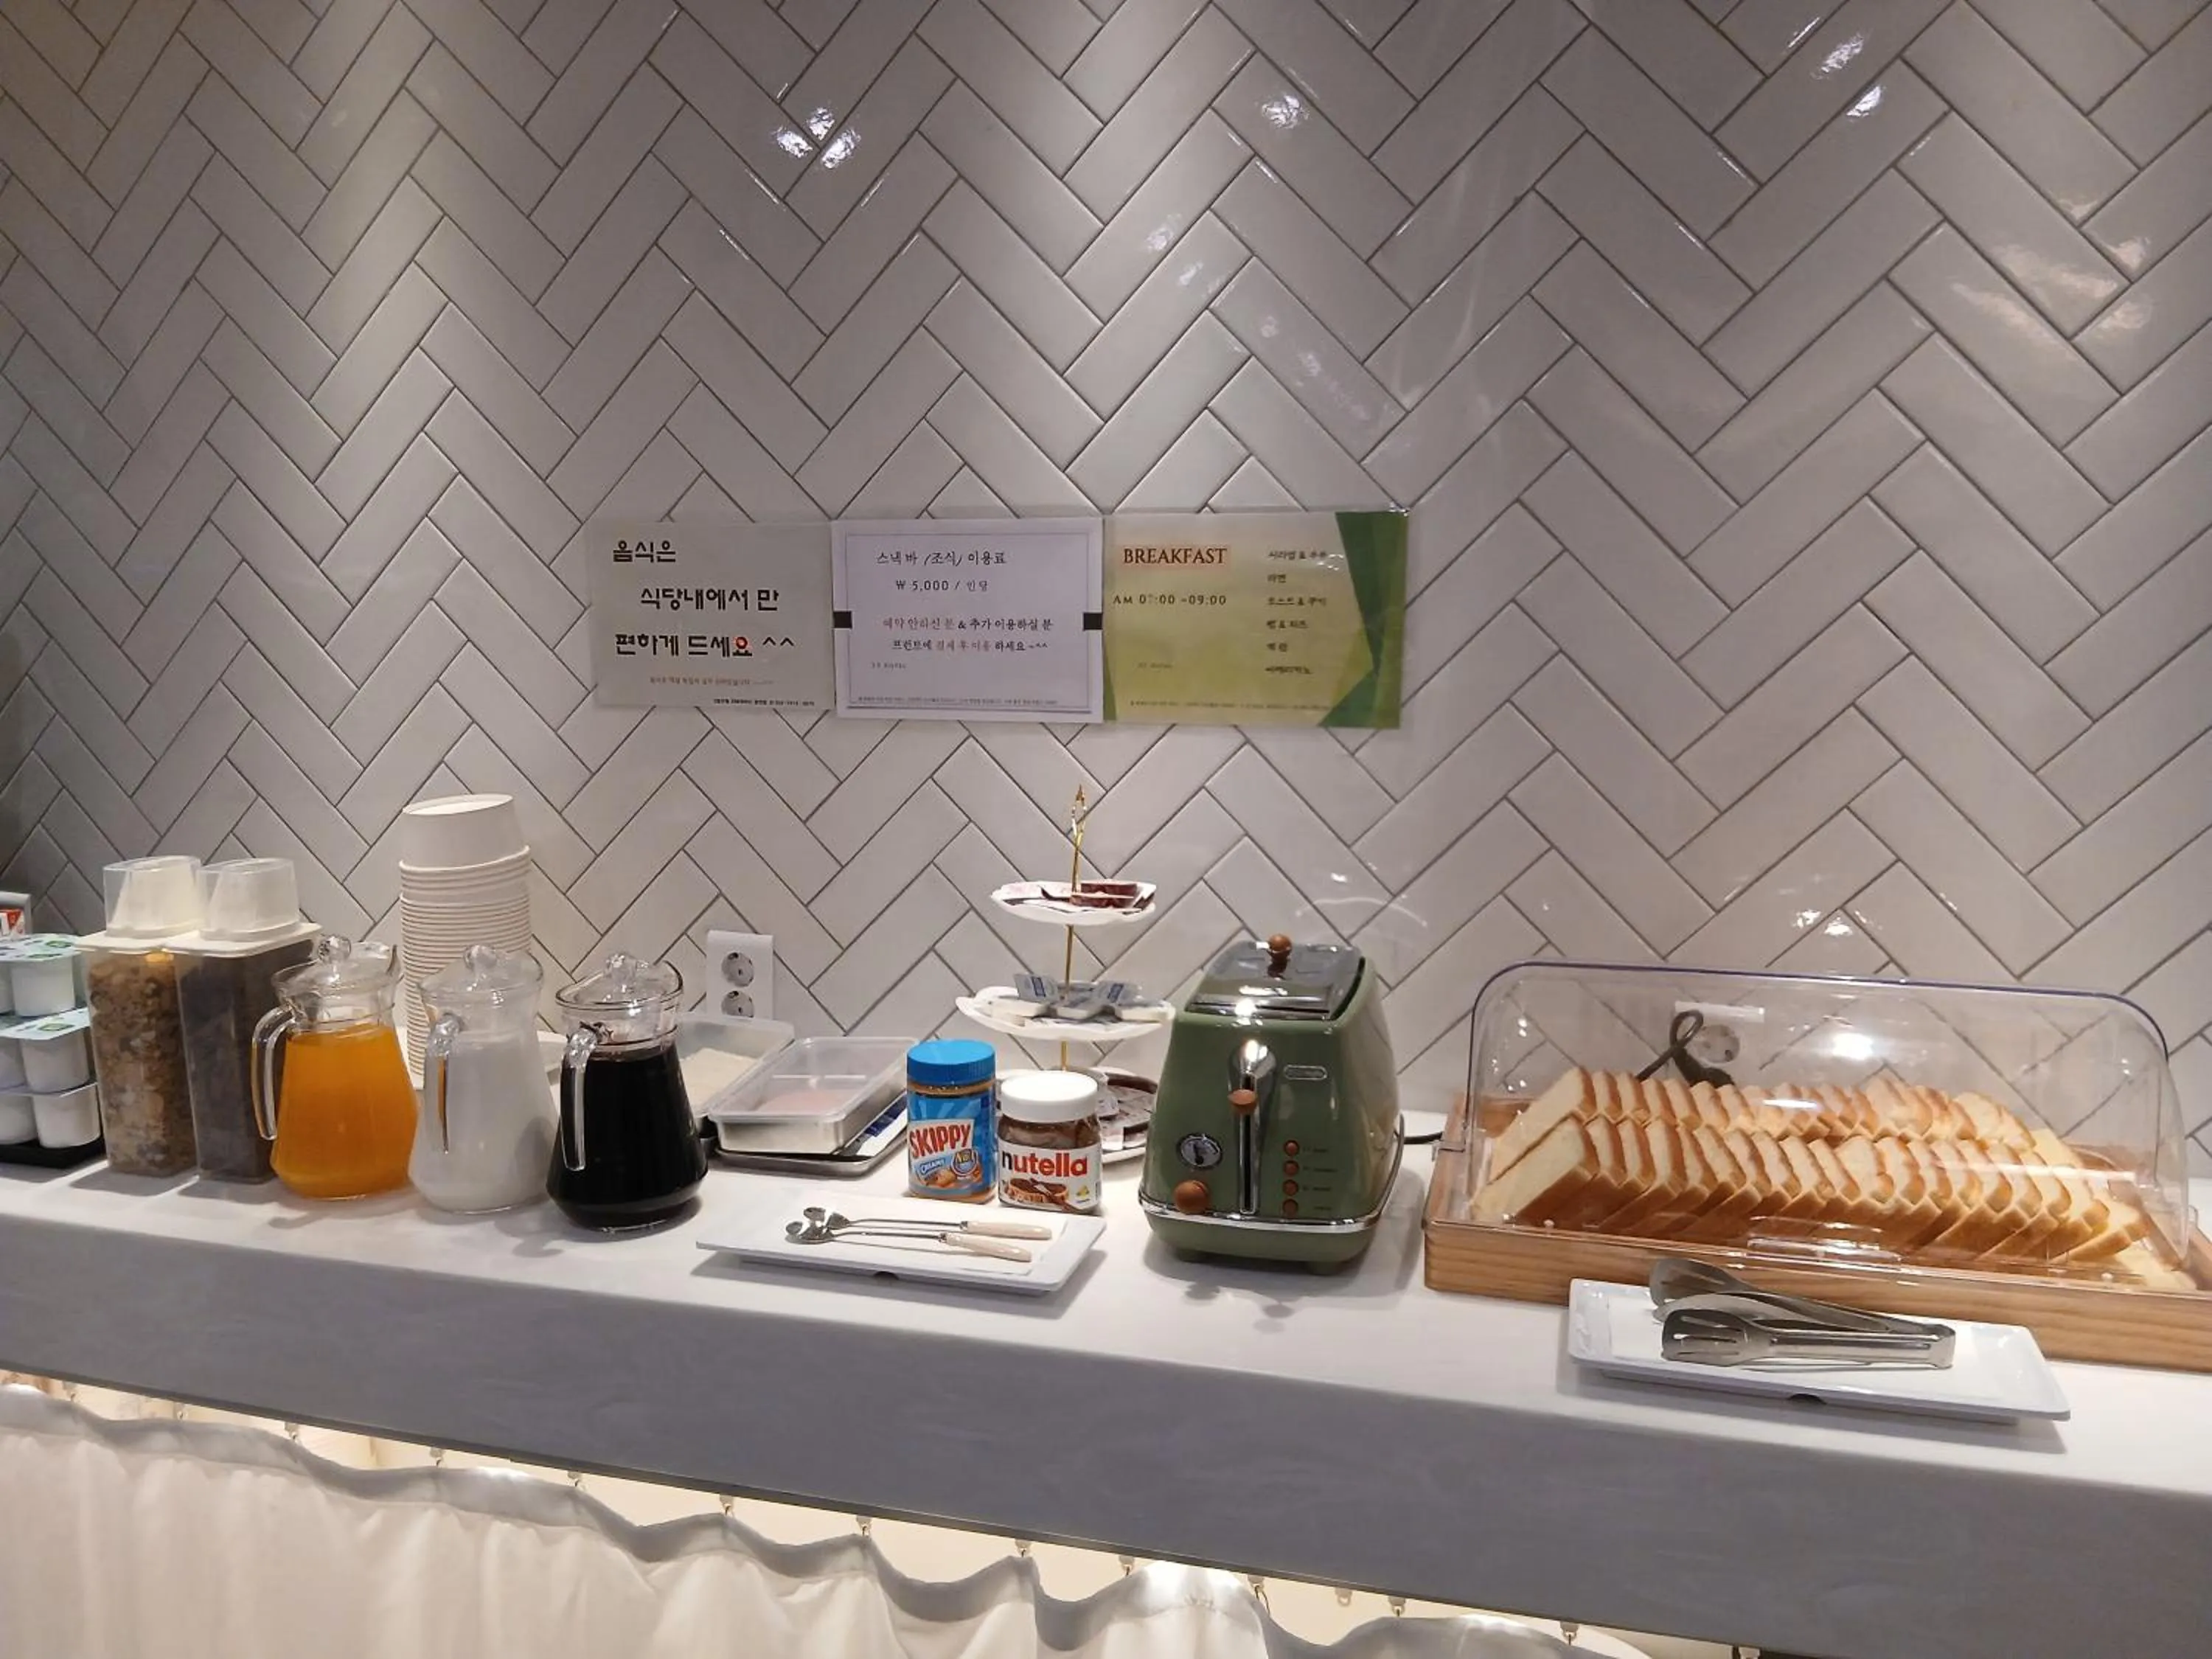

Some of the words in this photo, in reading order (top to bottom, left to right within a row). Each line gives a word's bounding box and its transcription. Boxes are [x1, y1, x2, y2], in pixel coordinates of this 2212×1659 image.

[613, 540, 676, 563] 음식은
[1123, 547, 1228, 564] BREAKFAST
[1112, 594, 1133, 605] AM
[970, 617, 992, 630] 추가
[615, 633, 679, 656] 편하게
[688, 636, 754, 658] 드세요
[908, 1123, 972, 1159] SKIPPY
[1001, 1150, 1088, 1178] nutella
